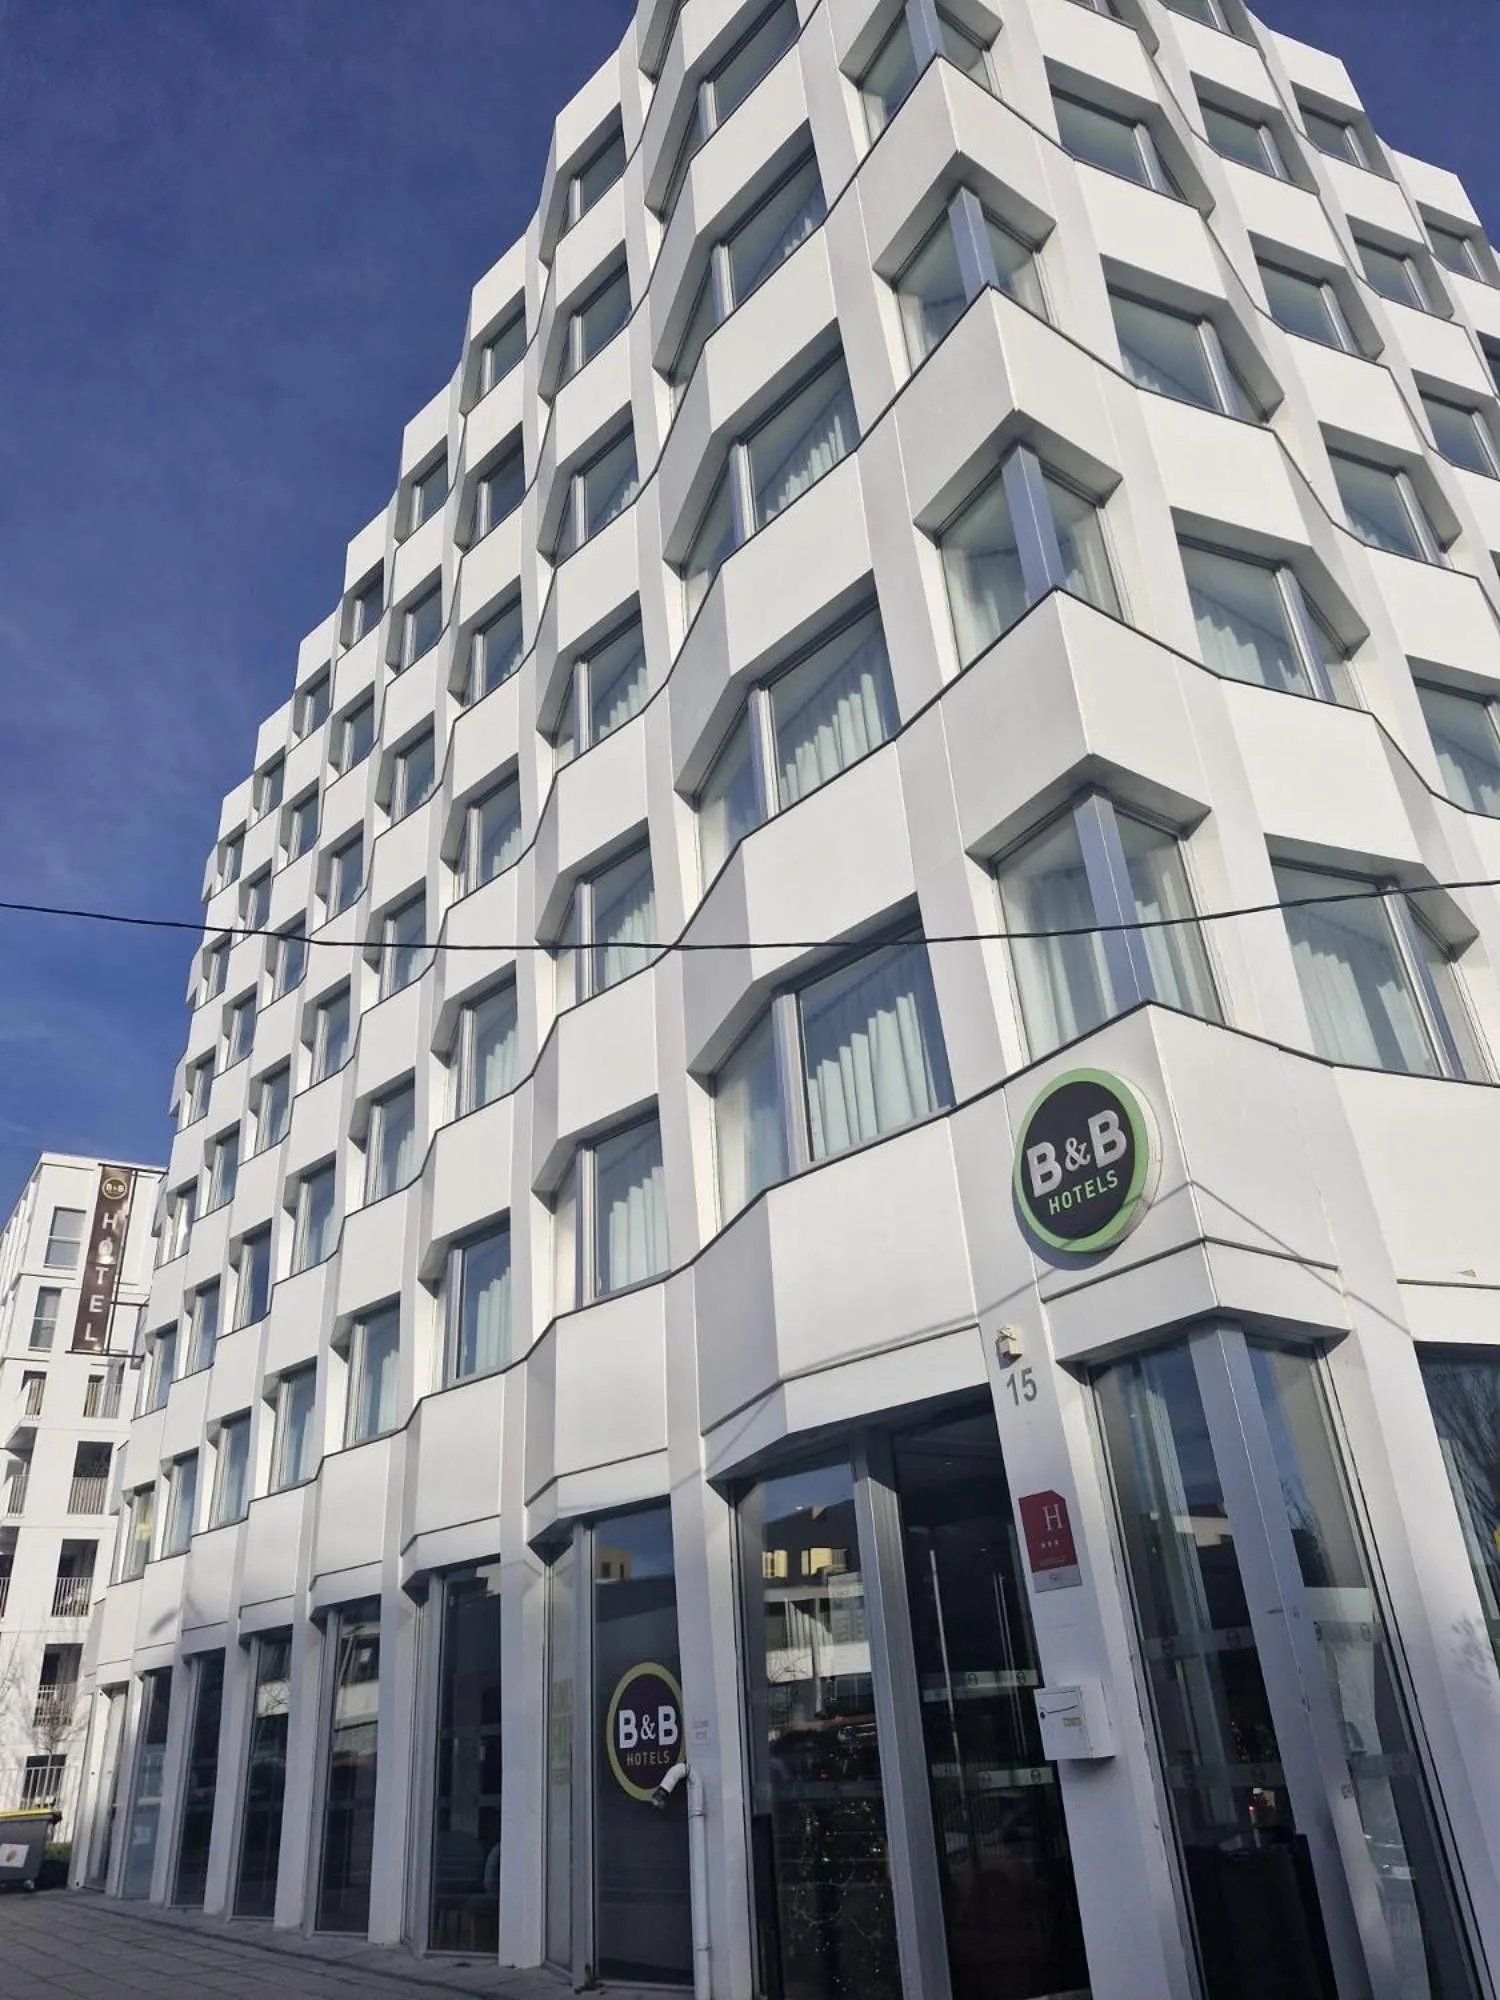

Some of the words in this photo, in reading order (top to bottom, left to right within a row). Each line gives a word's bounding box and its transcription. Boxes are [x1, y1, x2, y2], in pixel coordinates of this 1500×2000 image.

[1026, 1110, 1127, 1198] B&B
[1048, 1169, 1119, 1216] HOTELS
[1006, 1367, 1037, 1406] 15
[1041, 1503, 1063, 1531] H
[618, 1705, 679, 1749] B&B
[626, 1750, 671, 1767] HOTELS
